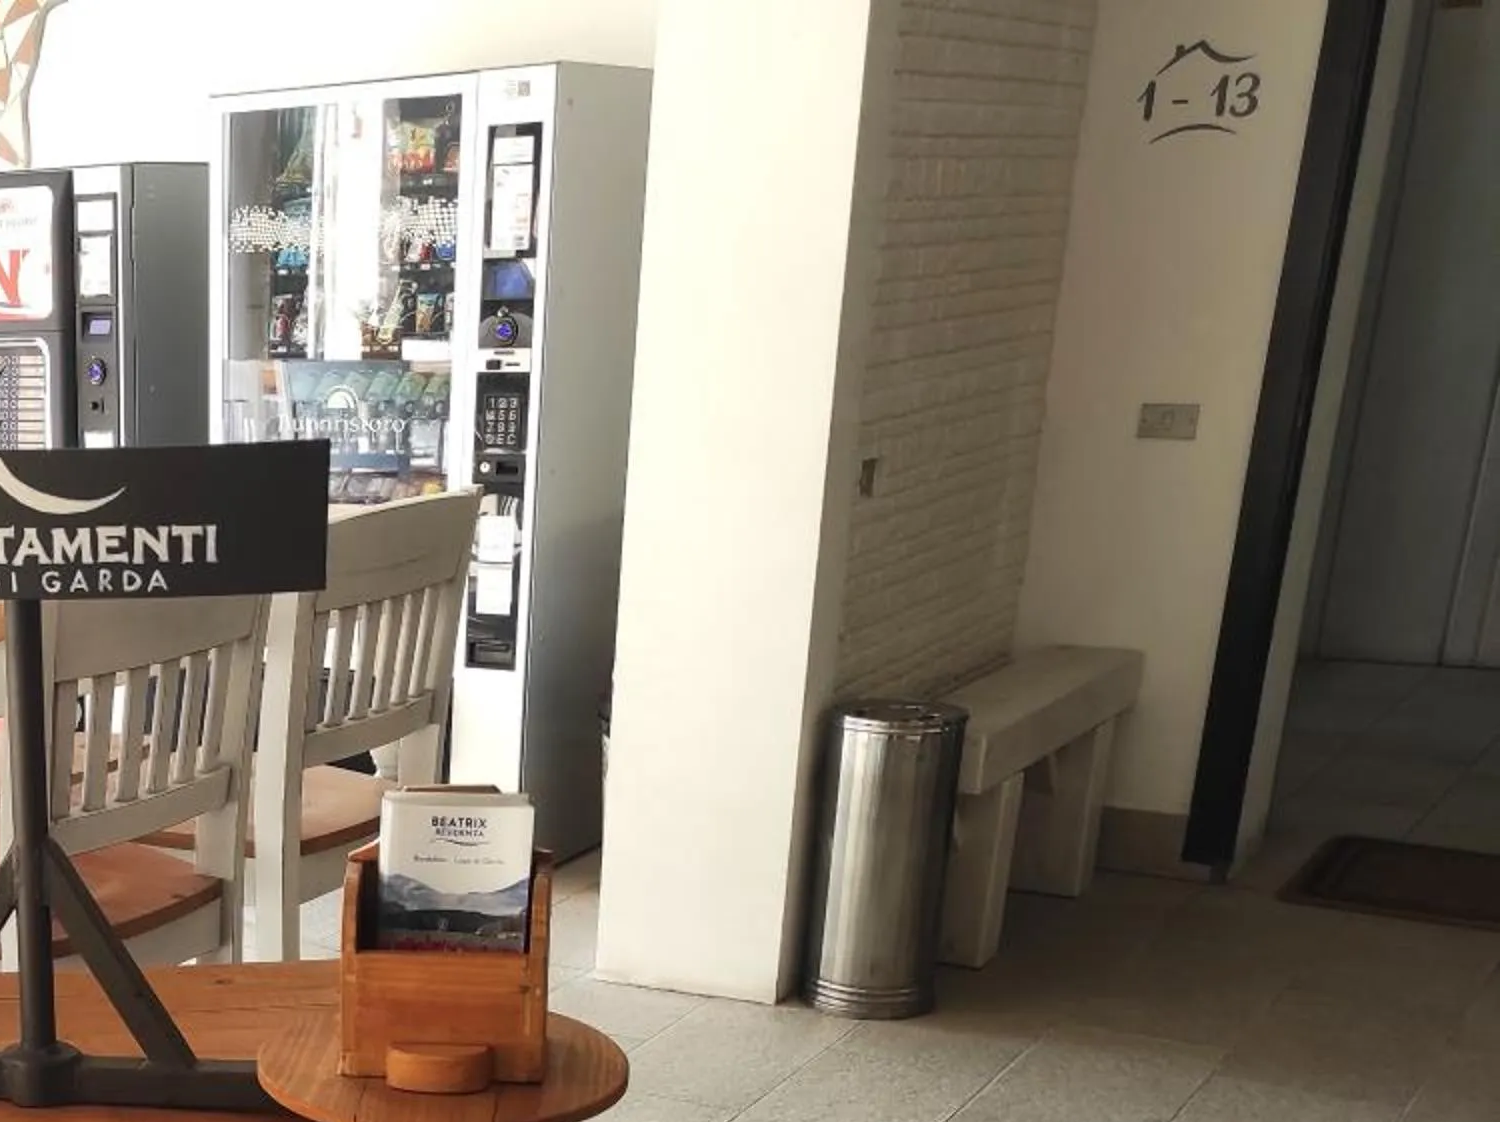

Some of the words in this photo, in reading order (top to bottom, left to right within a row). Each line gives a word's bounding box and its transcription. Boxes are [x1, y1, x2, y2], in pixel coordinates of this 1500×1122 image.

[1136, 79, 1157, 122] 1
[1209, 71, 1262, 118] 13
[42, 567, 169, 593] GARDA
[430, 815, 488, 828] BEATRIX
